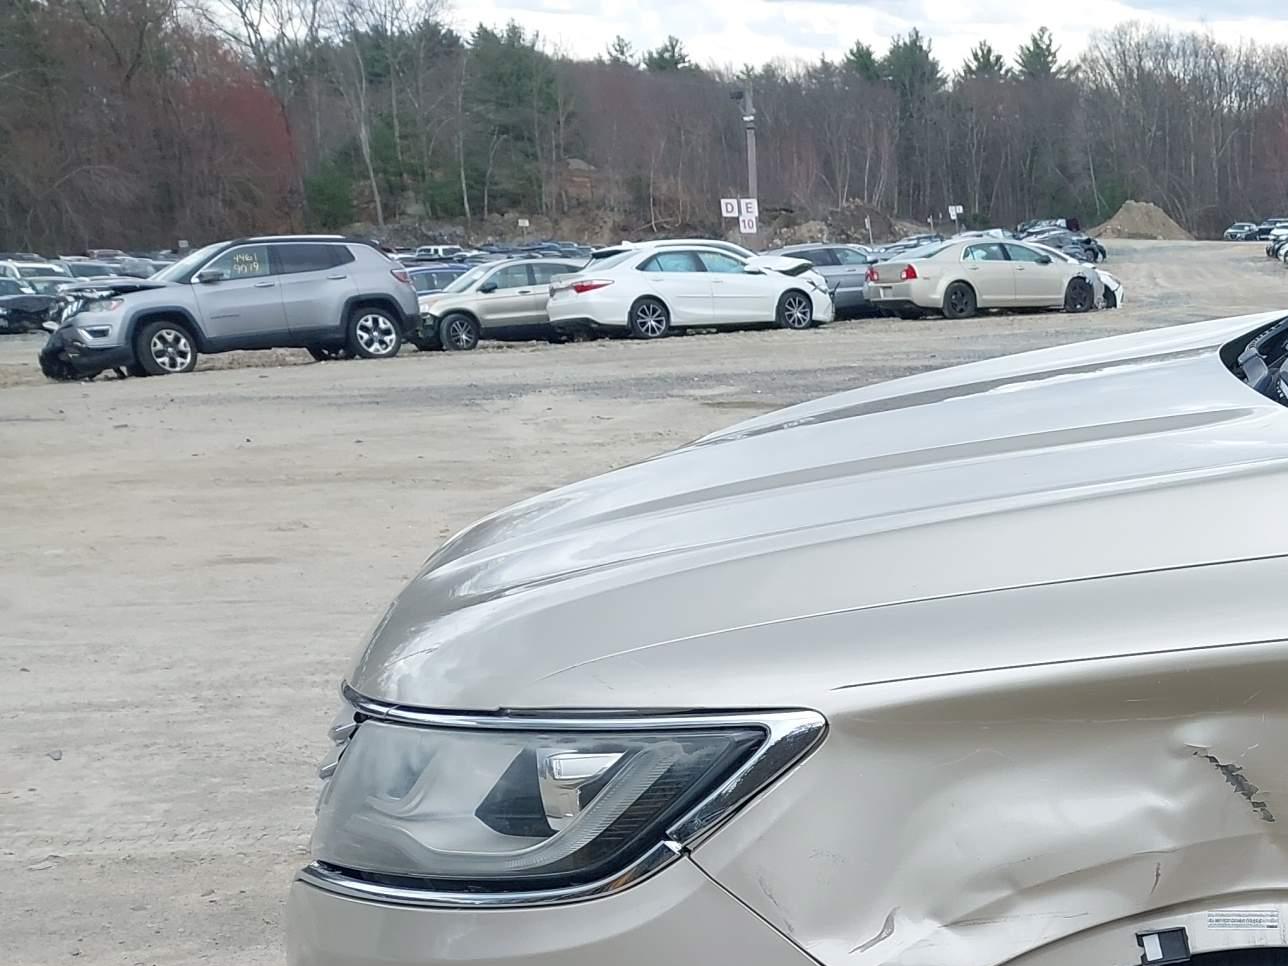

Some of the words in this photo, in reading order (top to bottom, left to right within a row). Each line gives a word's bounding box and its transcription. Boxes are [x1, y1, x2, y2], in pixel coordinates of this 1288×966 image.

[725, 202, 735, 214] D
[745, 202, 753, 214] E
[741, 219, 754, 229] 10
